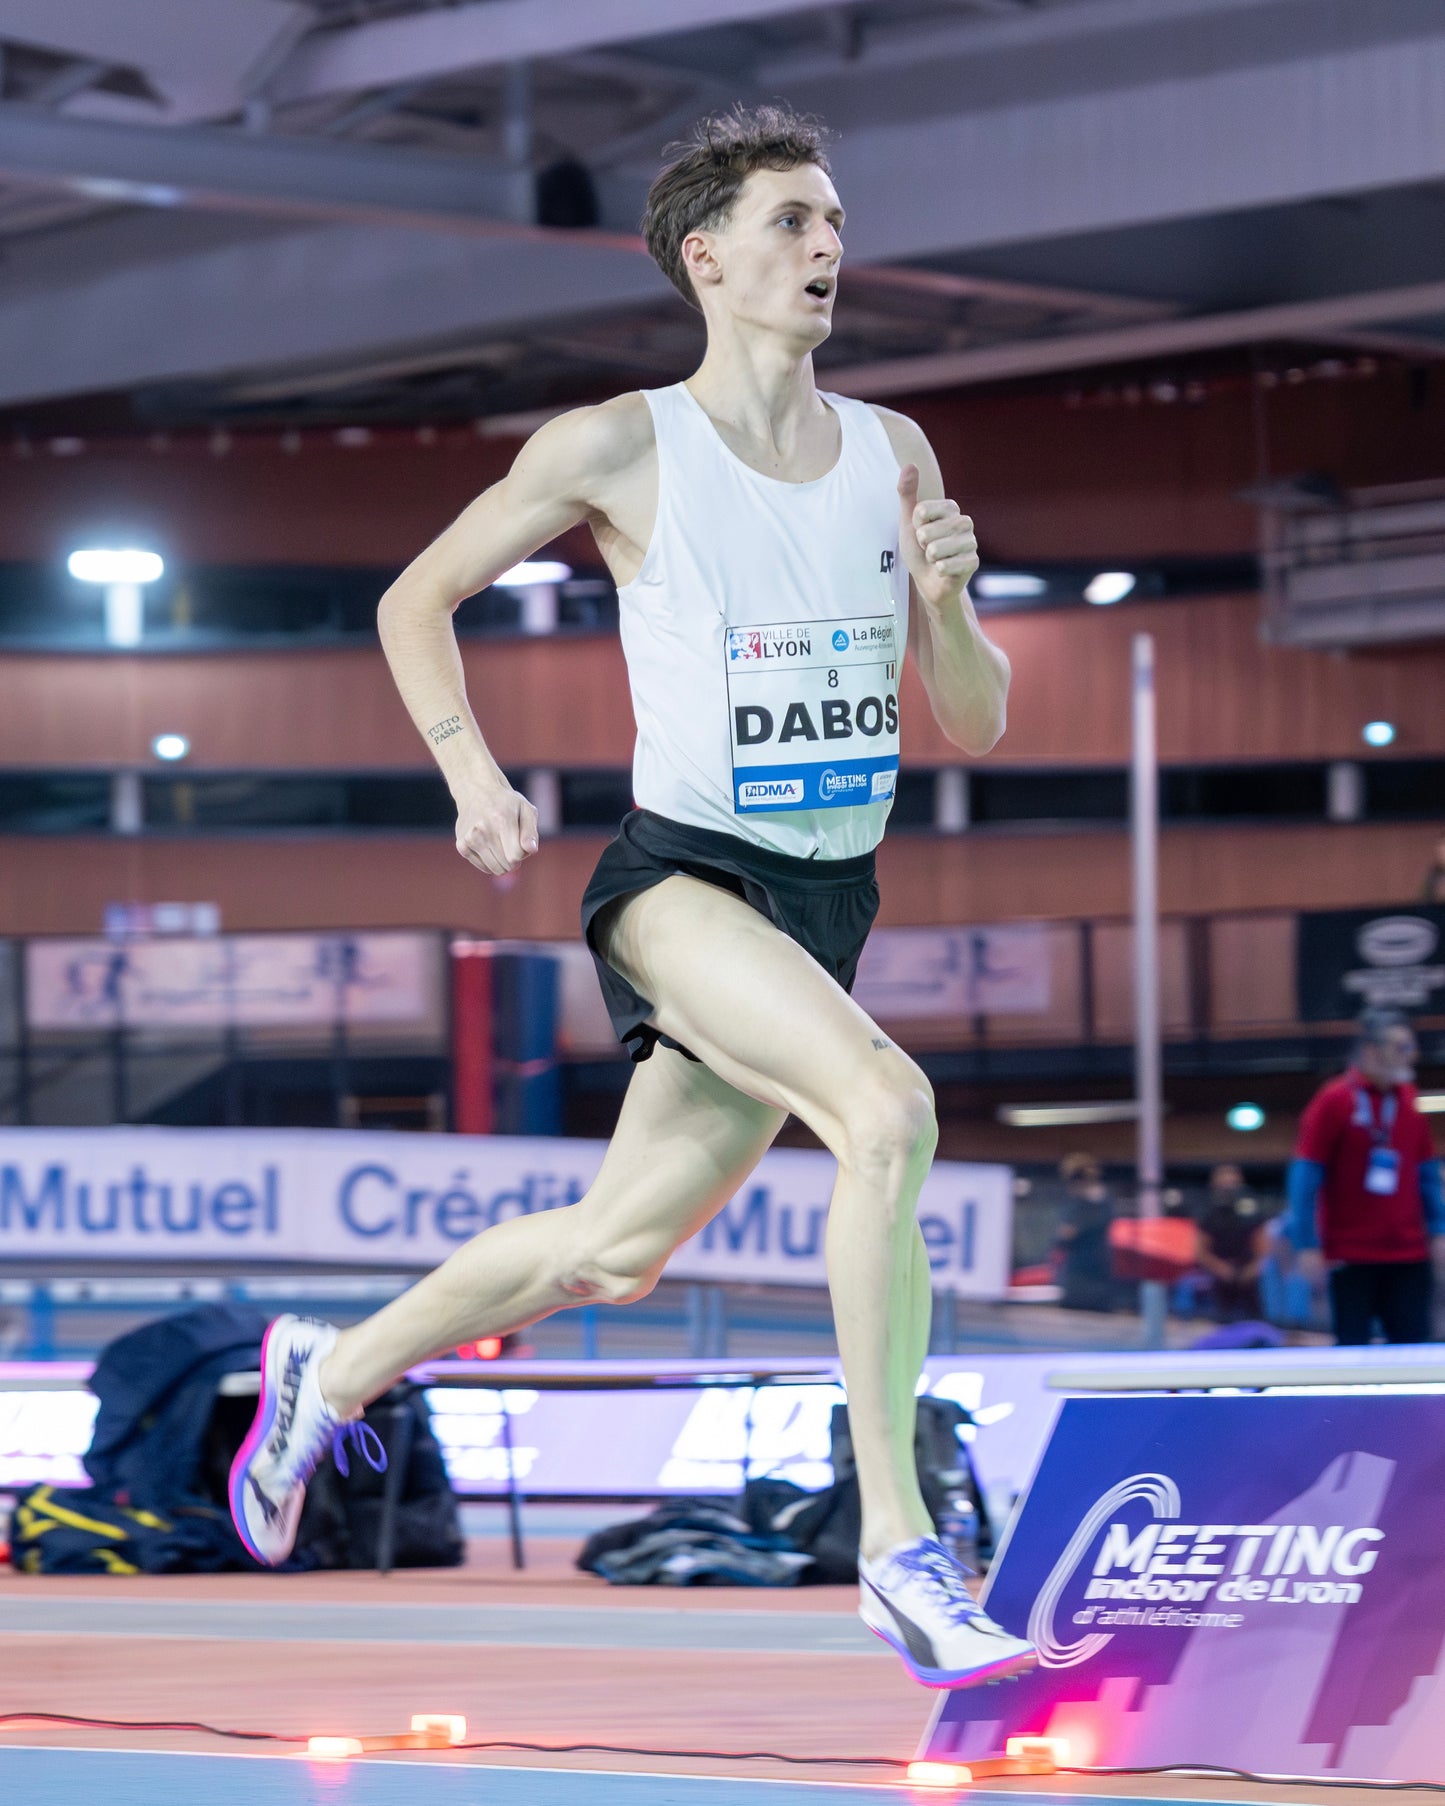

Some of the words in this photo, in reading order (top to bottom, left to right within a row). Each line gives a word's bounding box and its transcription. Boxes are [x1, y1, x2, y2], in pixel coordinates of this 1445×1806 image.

[762, 628, 792, 640] VILLE
[796, 627, 810, 638] DE
[853, 628, 868, 641] La
[763, 640, 811, 658] LYON
[828, 669, 839, 688] 8
[427, 715, 460, 738] TUTTO
[735, 694, 898, 746] DABOS
[434, 724, 464, 745] PASSA
[826, 774, 867, 786] MEETING
[0, 1162, 281, 1236] Mutuel
[699, 1184, 978, 1272] Muel
[1091, 1523, 1386, 1577] MEETING
[1083, 1573, 1217, 1601] indoor
